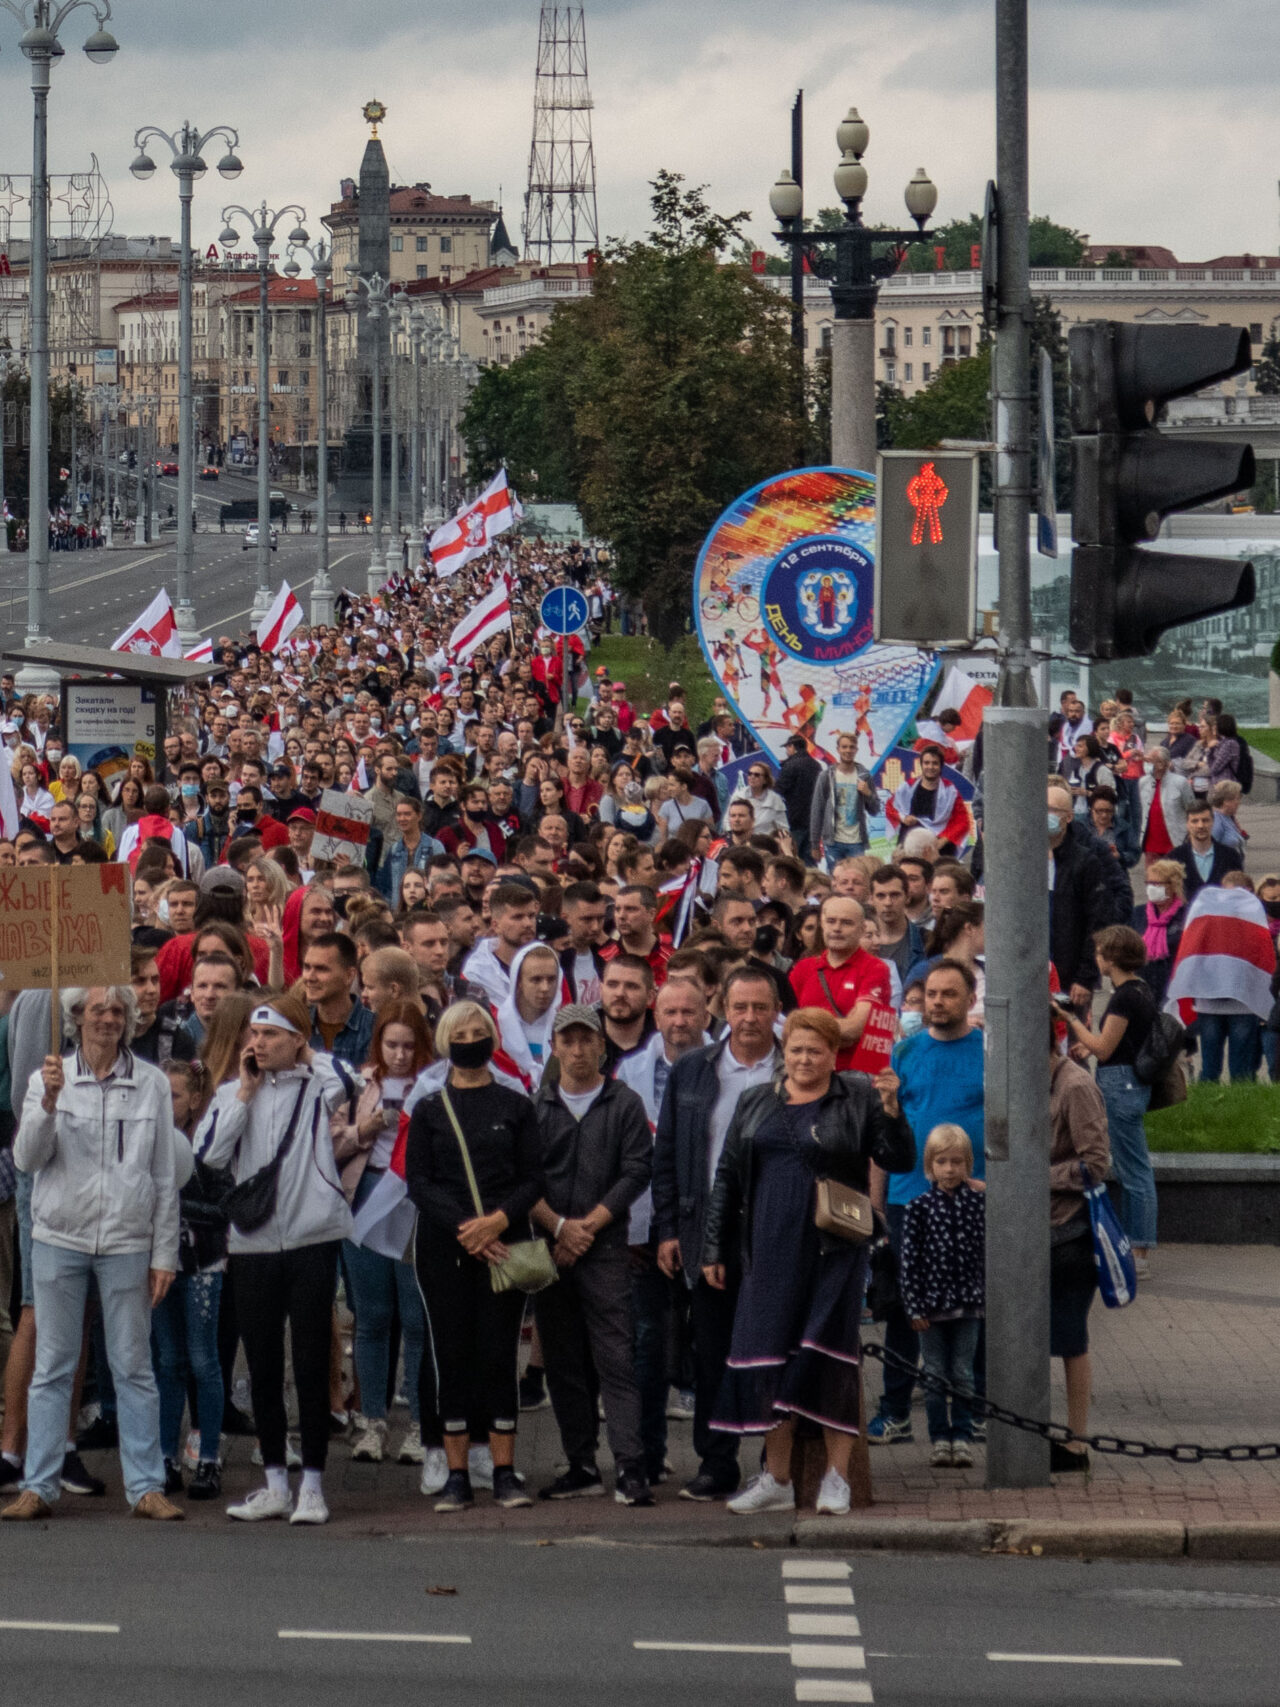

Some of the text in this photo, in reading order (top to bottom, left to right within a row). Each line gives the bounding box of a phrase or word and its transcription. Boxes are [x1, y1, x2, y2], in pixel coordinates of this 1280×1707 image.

[781, 544, 868, 569] 12 сентября
[765, 604, 803, 651] ДЕНЬ
